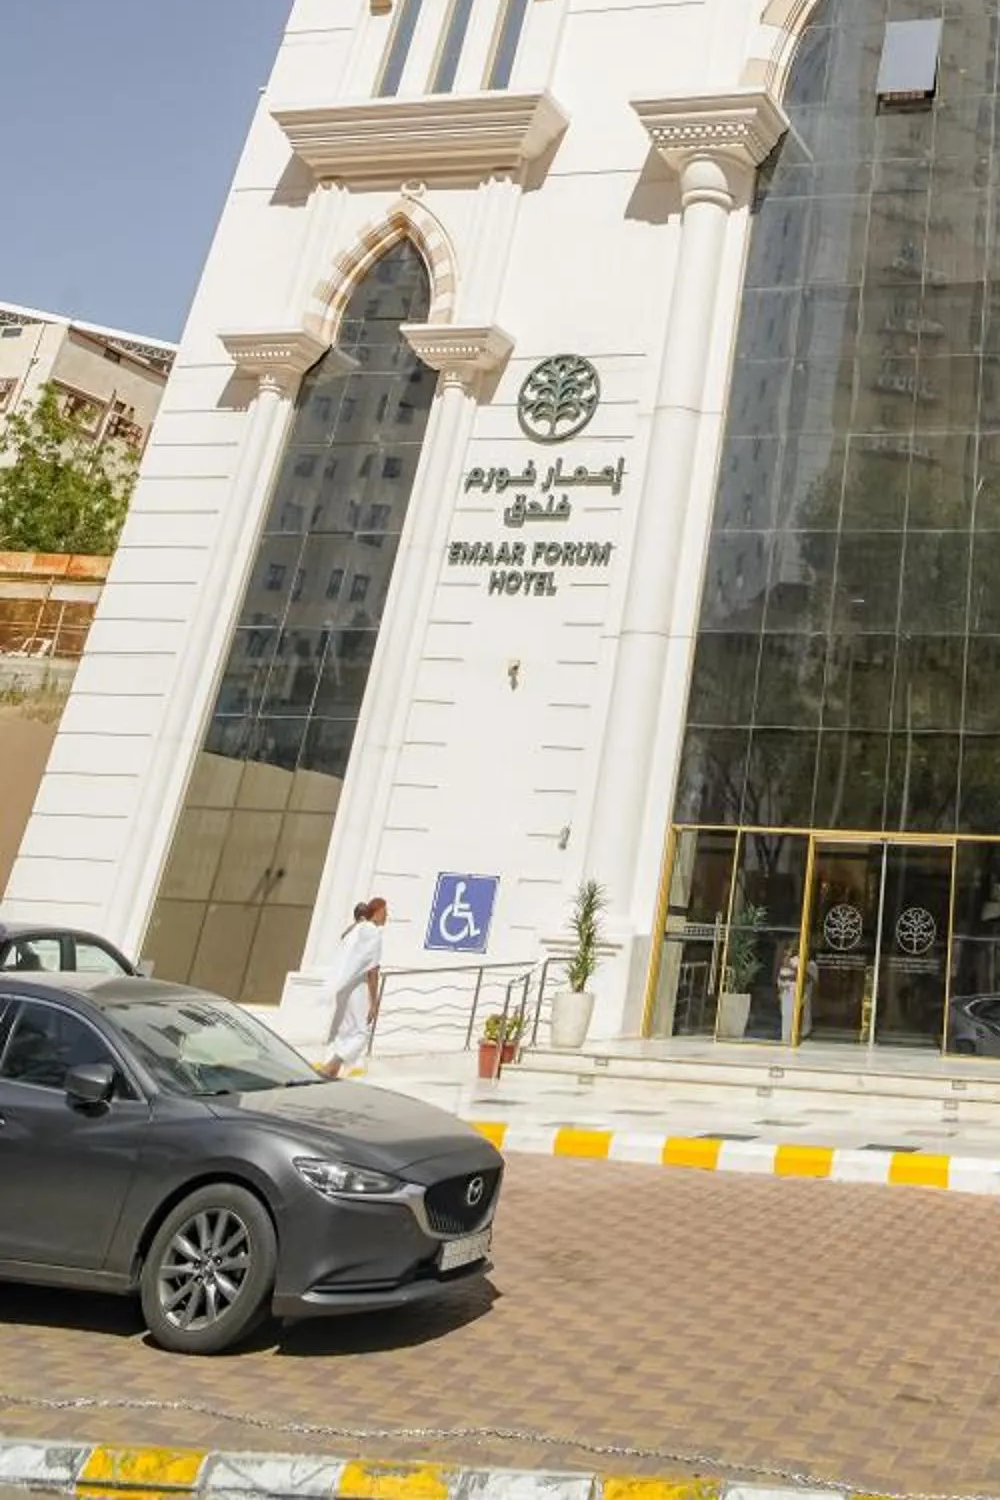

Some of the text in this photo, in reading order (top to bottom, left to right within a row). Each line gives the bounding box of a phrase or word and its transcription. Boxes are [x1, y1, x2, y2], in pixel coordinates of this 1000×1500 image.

[464, 459, 537, 494] فورم
[503, 493, 572, 528] فندق
[448, 542, 614, 567] EMAAR FORUM
[487, 571, 557, 597] HOTEL
